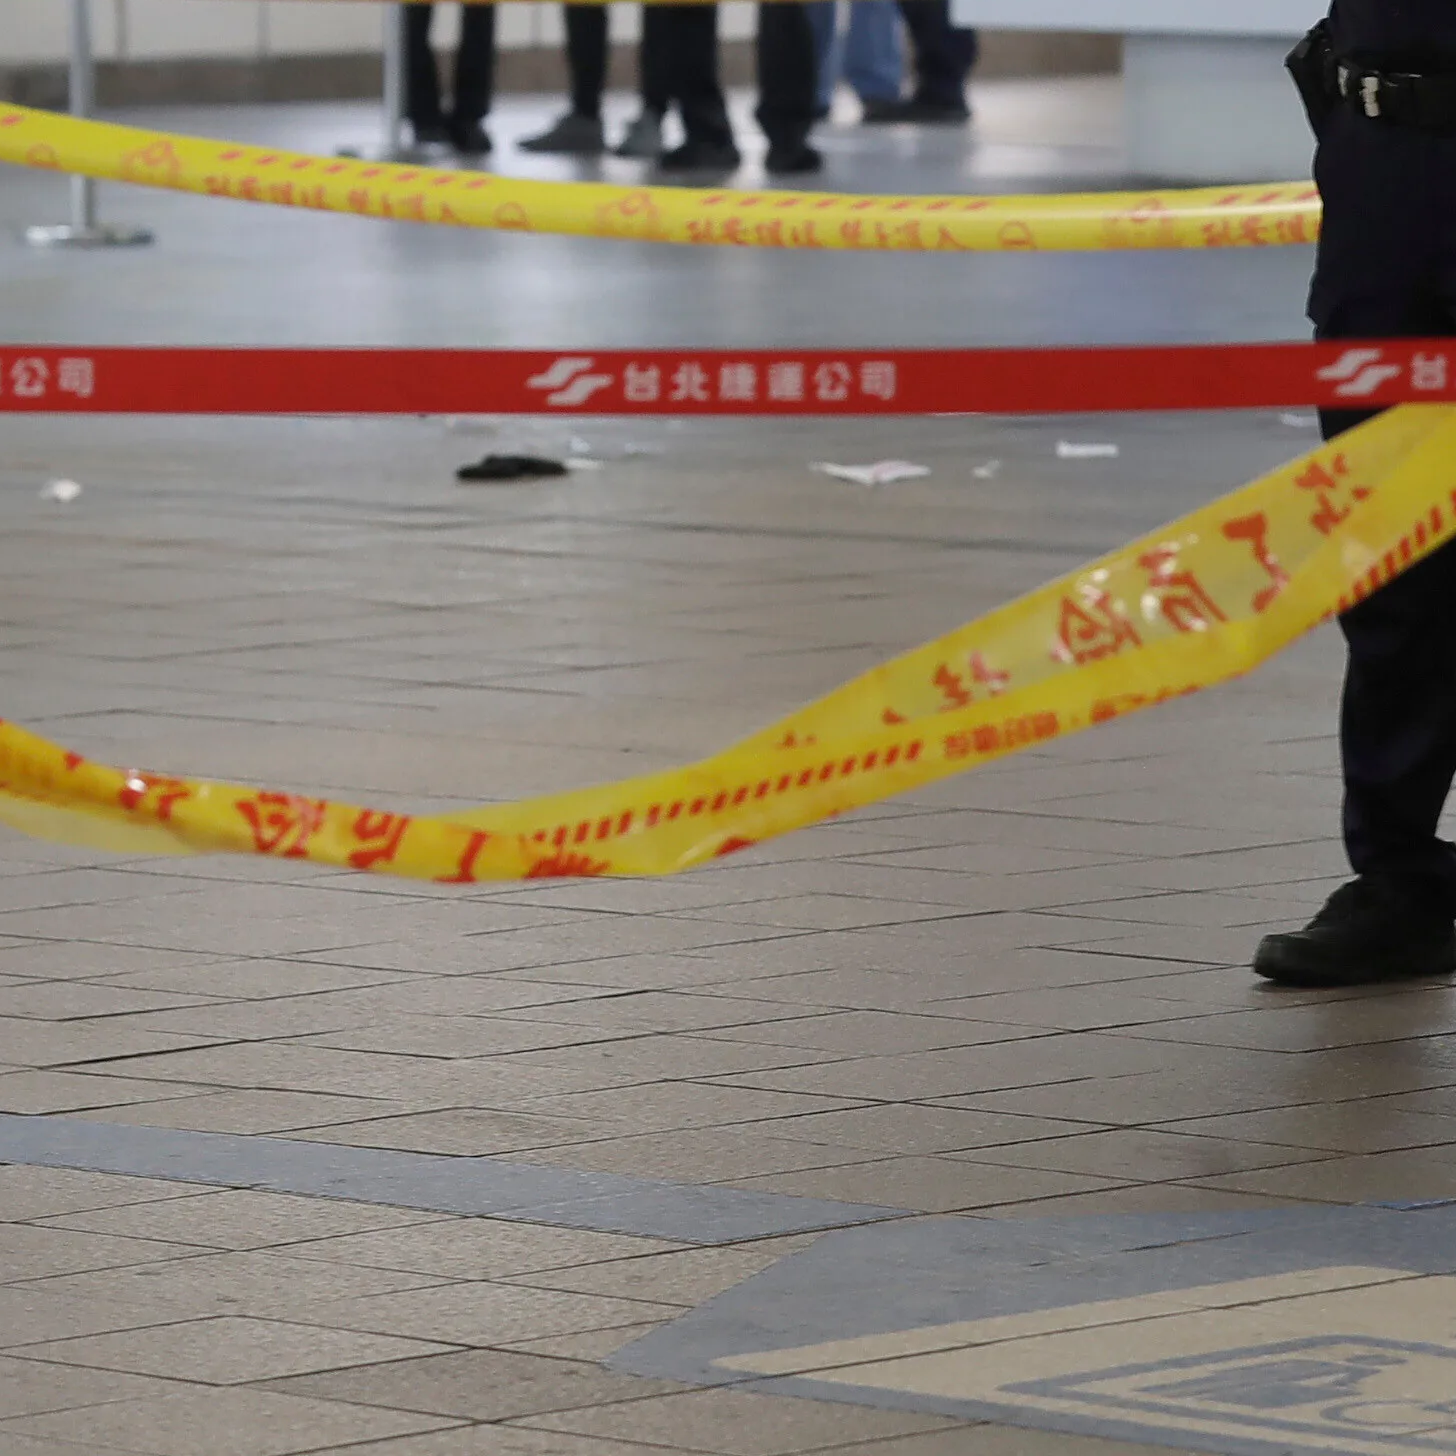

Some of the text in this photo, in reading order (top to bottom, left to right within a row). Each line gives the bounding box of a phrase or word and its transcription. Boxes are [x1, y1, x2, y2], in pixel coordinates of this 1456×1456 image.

[622, 360, 897, 402] 台北捷運公司
